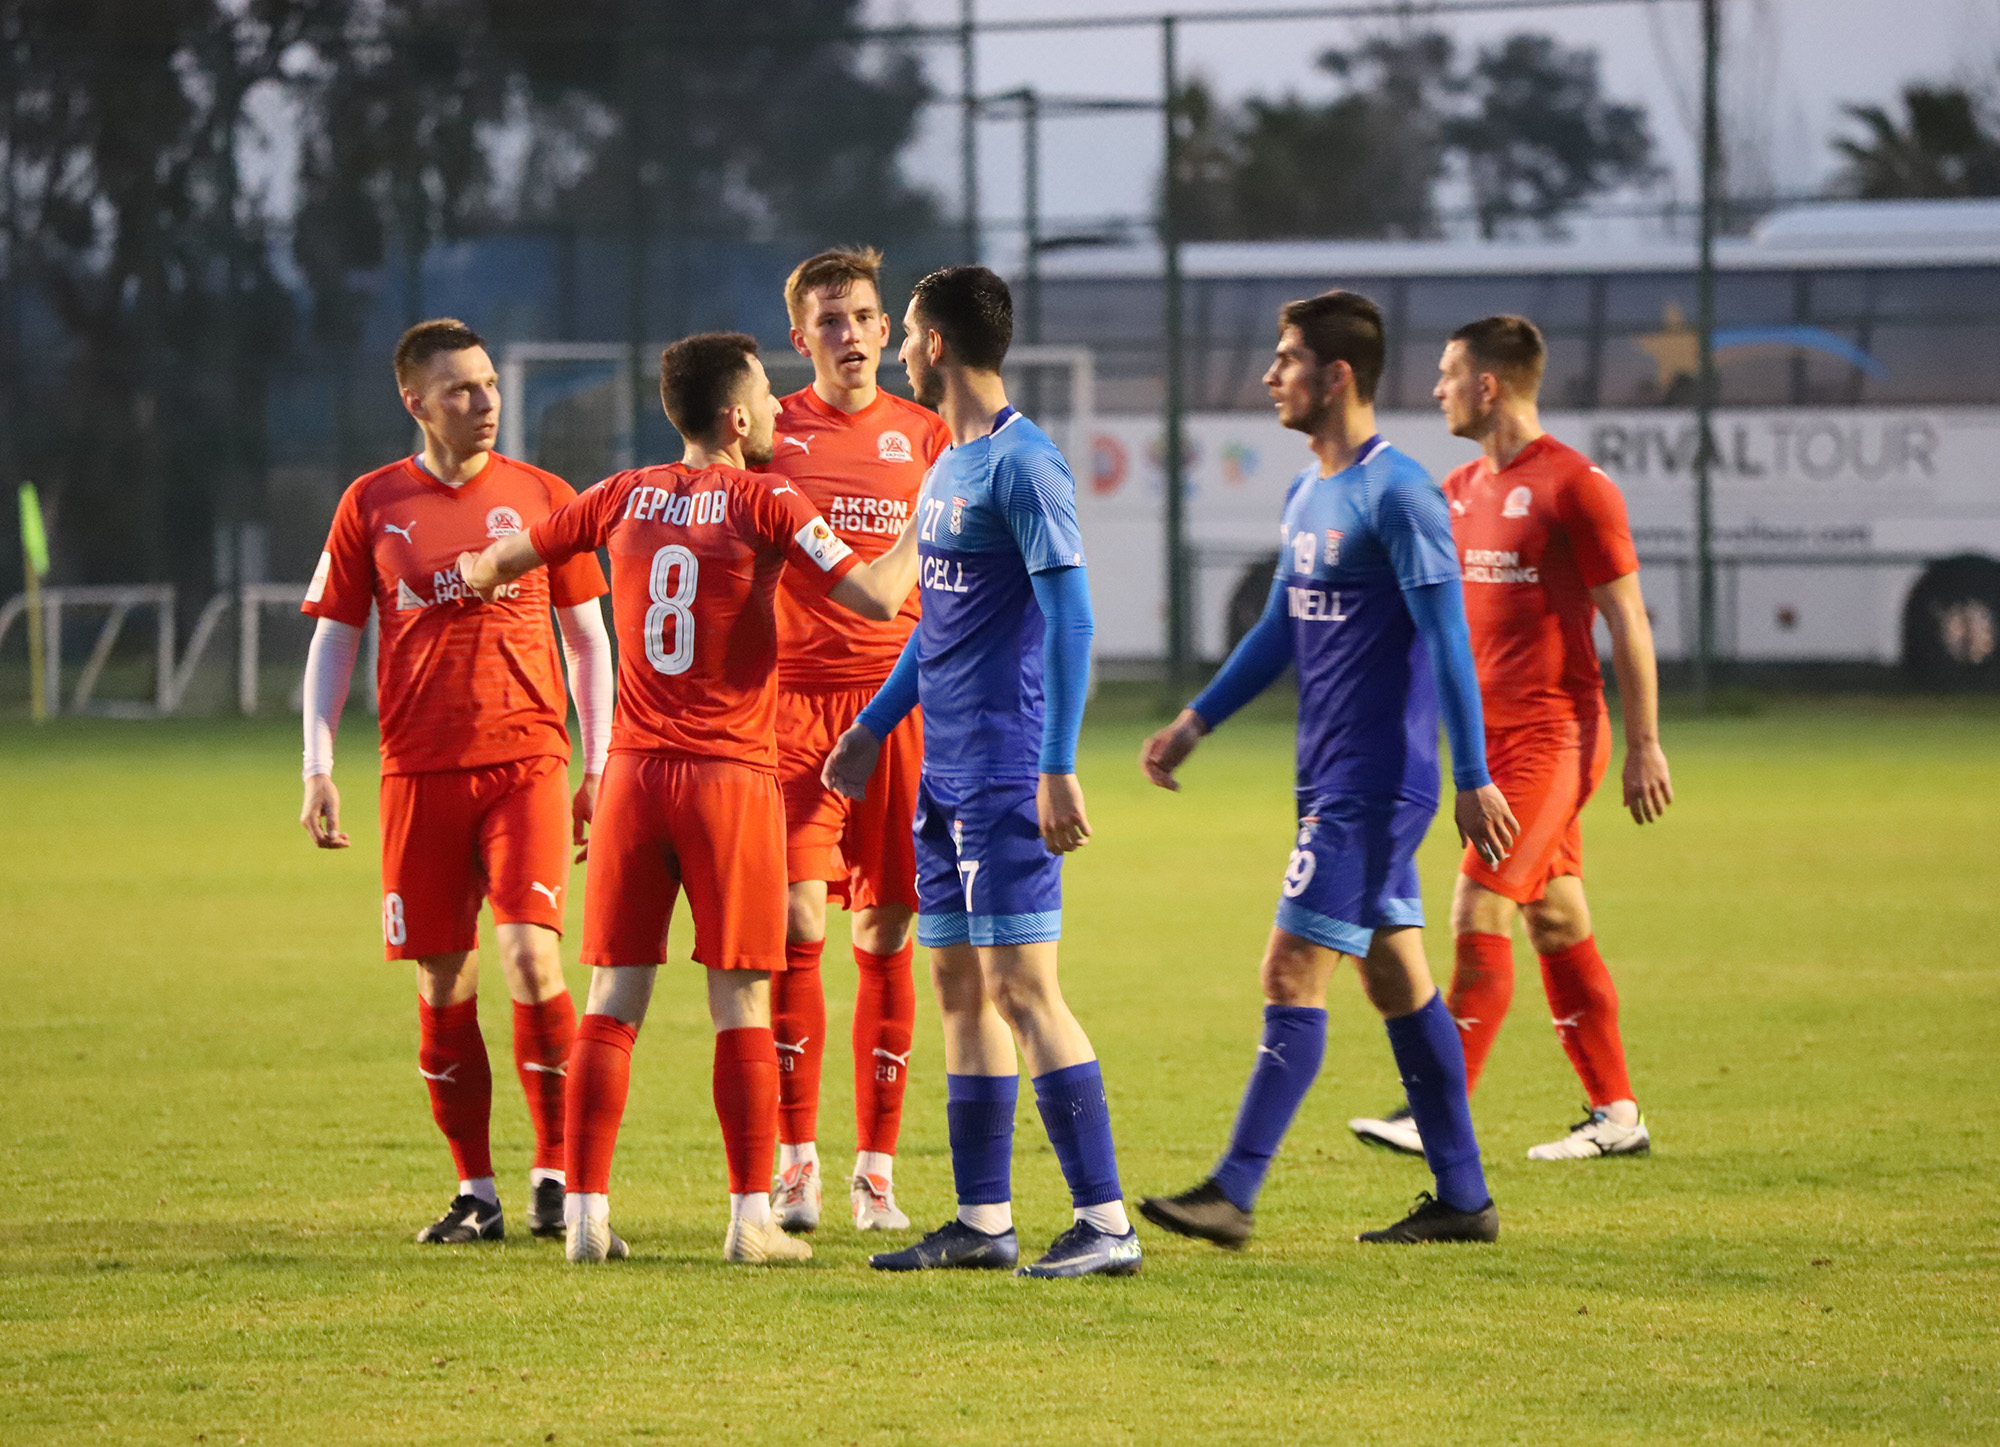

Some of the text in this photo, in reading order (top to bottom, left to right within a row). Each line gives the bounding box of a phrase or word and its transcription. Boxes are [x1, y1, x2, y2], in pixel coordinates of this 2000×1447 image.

[830, 496, 908, 518] AKRON
[830, 513, 909, 535] HOLDIN
[921, 498, 945, 543] 27
[434, 583, 521, 605] HOLNG
[644, 544, 699, 675] 8
[874, 1065, 897, 1083] 29
